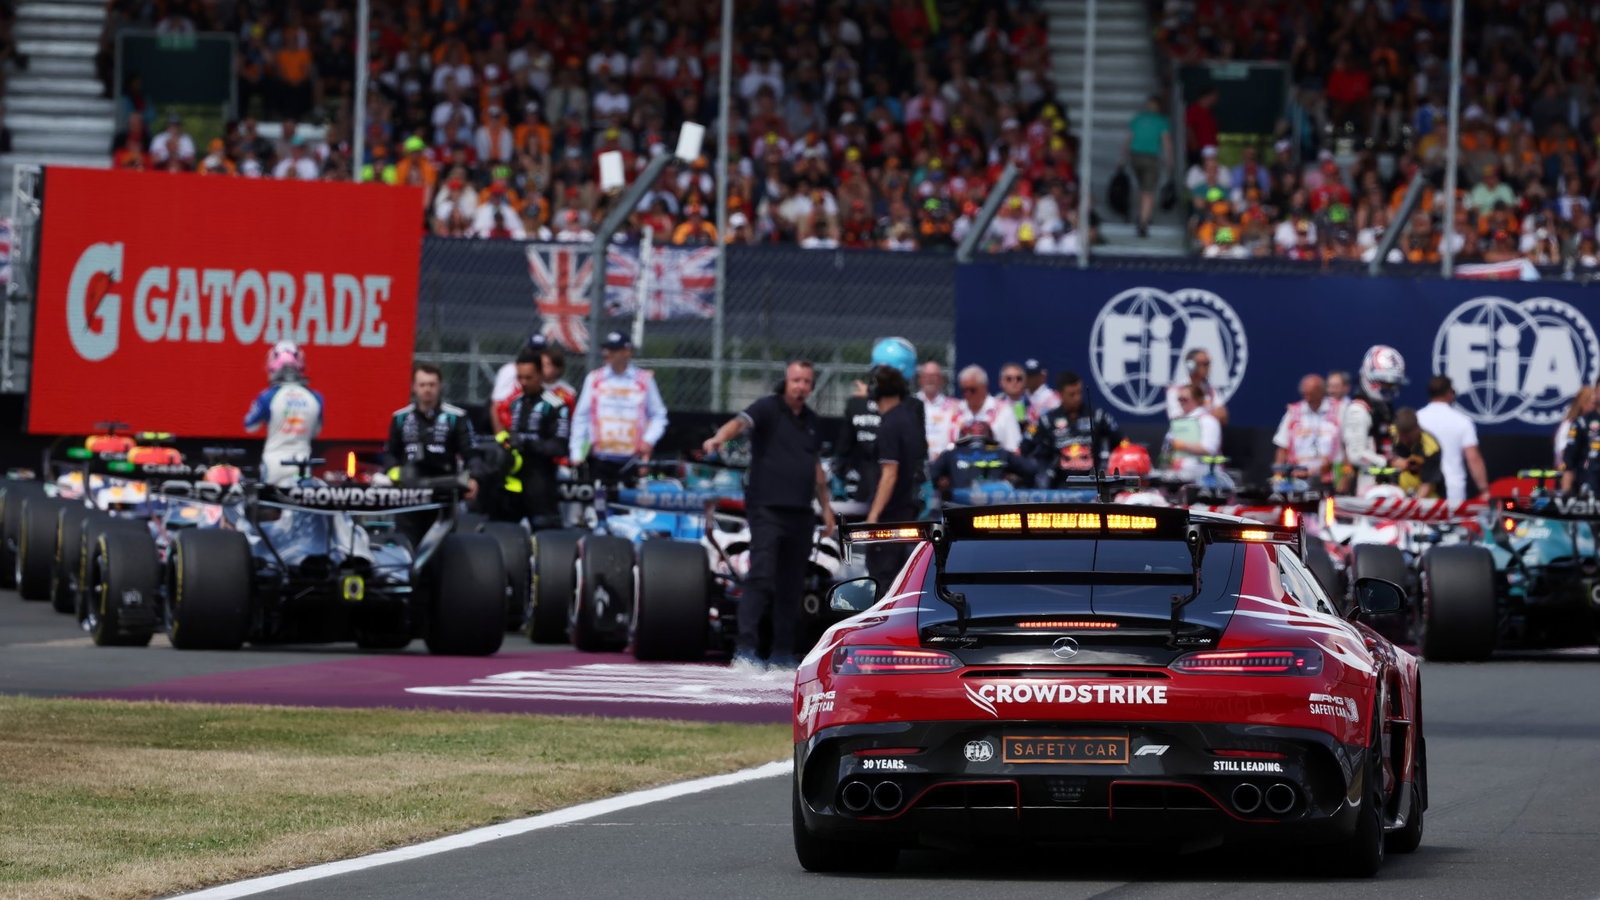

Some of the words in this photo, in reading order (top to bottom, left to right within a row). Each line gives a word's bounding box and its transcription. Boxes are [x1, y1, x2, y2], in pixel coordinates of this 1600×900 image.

[133, 266, 391, 347] GATORADE
[289, 487, 434, 505] CROWDSTRIKE
[978, 684, 1168, 705] CROWDSTRIKE
[1309, 703, 1335, 717] SAFETY
[1013, 743, 1077, 756] SAFETY
[1084, 744, 1118, 756] CAR
[863, 759, 874, 769] 30
[876, 759, 907, 769] YEARS.
[1213, 761, 1239, 771] STILL
[1241, 761, 1283, 773] LEADING.
